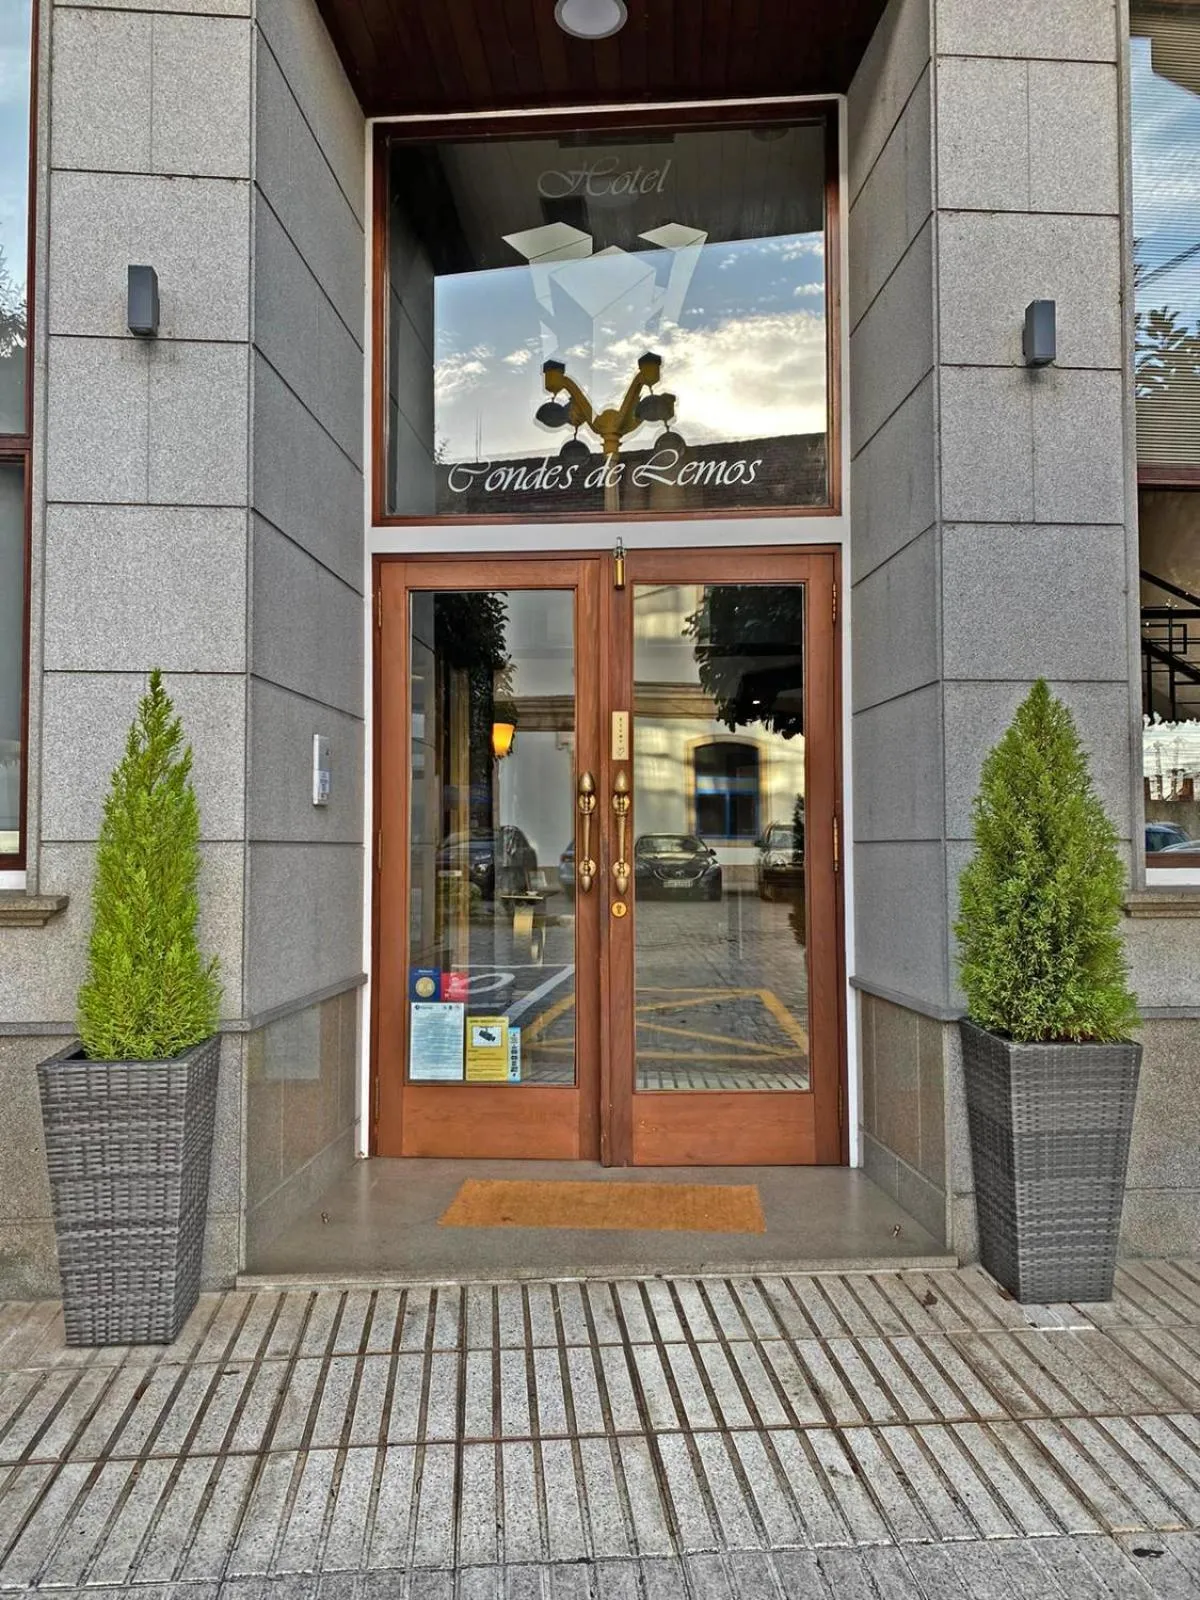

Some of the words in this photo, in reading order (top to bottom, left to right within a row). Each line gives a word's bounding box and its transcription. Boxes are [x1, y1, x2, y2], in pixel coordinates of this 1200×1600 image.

[537, 156, 672, 199] Hotel
[447, 456, 579, 493] Condes
[583, 452, 625, 490] de
[632, 448, 763, 488] Lemos
